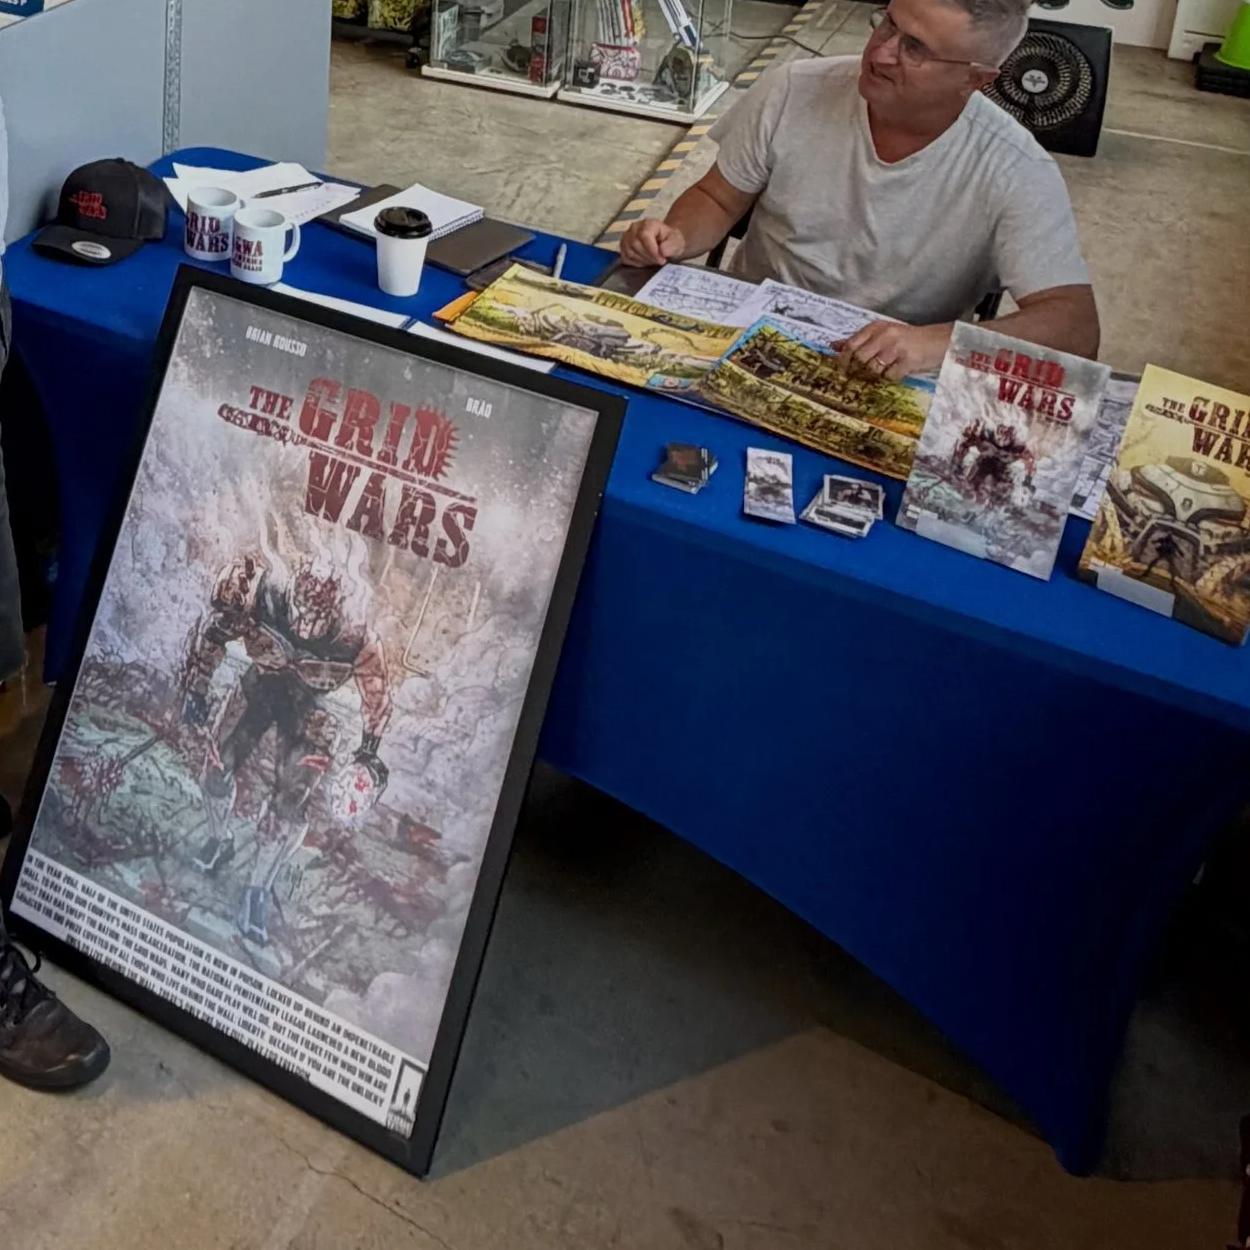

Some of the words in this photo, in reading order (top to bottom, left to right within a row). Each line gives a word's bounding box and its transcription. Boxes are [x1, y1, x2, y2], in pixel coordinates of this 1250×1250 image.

[186, 212, 220, 232] RID
[187, 230, 229, 253] WARS
[245, 325, 270, 345] BRIAN
[993, 348, 1066, 390] GRID
[998, 378, 1076, 423] WARS
[1163, 397, 1186, 413] THE
[249, 384, 294, 419] THE
[298, 376, 461, 480] GRID
[1192, 426, 1250, 471] WAR
[304, 450, 478, 568] WARS
